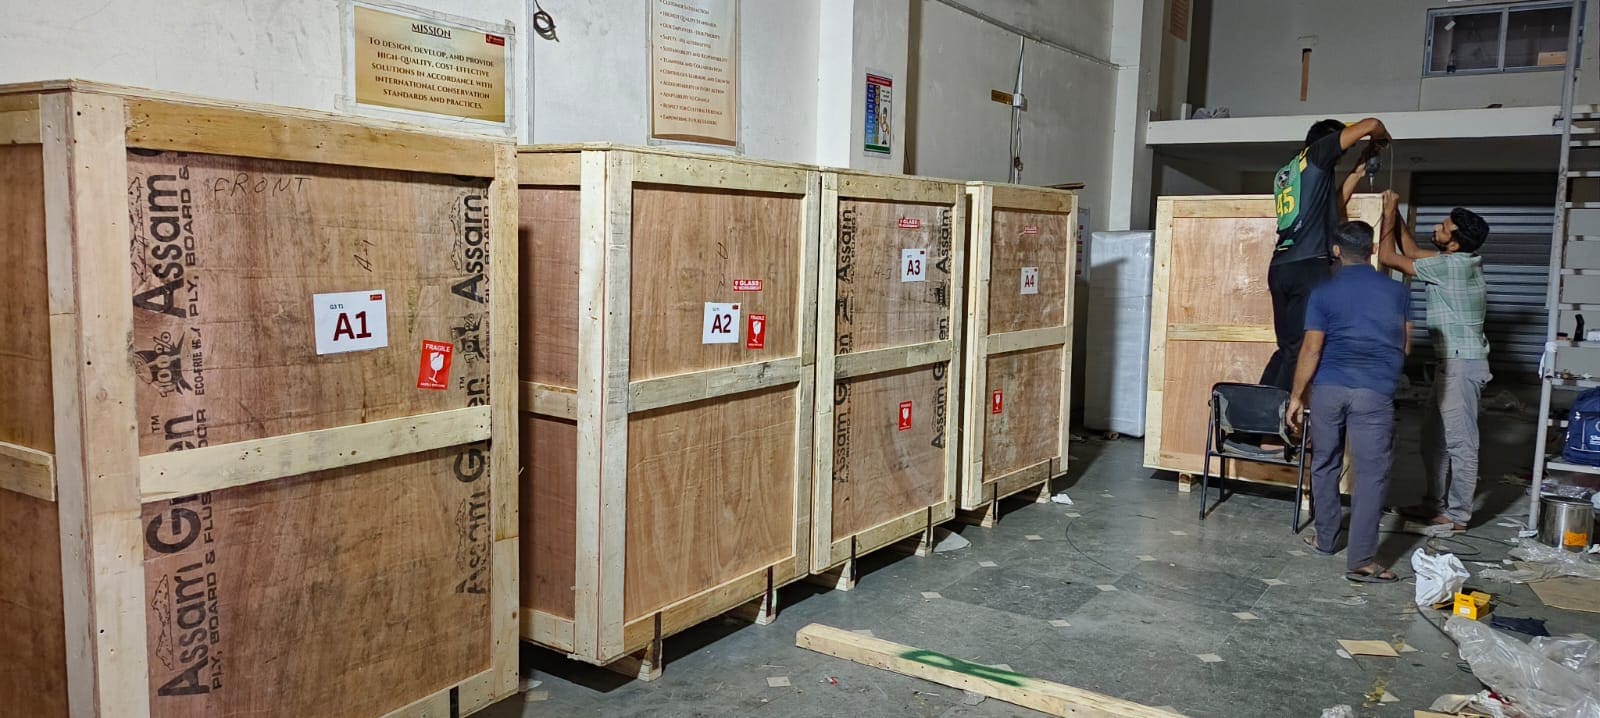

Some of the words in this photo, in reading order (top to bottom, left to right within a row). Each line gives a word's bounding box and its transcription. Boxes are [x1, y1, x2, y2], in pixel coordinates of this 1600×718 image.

[411, 23, 451, 38] MISSION
[368, 36, 380, 46] TO
[382, 40, 412, 51] DESIGN,
[414, 46, 448, 60] DEVELOP,
[450, 52, 464, 62] AND
[466, 56, 494, 68] PROVIDE
[377, 50, 434, 68] HIGH-QUALITY,
[436, 62, 489, 77] COST-EFFECTIVE
[371, 62, 415, 76] SOLUTIONS
[426, 72, 474, 86] ACCORDANCE
[476, 80, 492, 89] WITH
[375, 75, 436, 92] INTERNATIONAL
[437, 85, 490, 100] CONSERVATION
[383, 88, 428, 102] STANDARDS
[429, 95, 445, 104] AND
[446, 98, 482, 110] PRACTICES.
[213, 172, 312, 200] FRONT
[1276, 186, 1295, 216] 45
[180, 188, 196, 266] BOARD
[936, 209, 950, 274] Assam
[132, 174, 186, 318] Assam
[451, 194, 484, 304] Assam
[837, 209, 852, 284] Assam
[906, 260, 921, 276] A3
[1024, 274, 1035, 288] A4
[187, 275, 200, 318] PLY,
[333, 310, 372, 341] A1
[712, 314, 732, 334] A2
[425, 342, 450, 352] FRAGILE
[931, 386, 946, 449] Assam
[202, 491, 213, 544] FLUS
[206, 550, 216, 564] &
[206, 572, 220, 644] BOARD
[158, 562, 210, 696] Assam
[212, 650, 223, 690] PLY,
